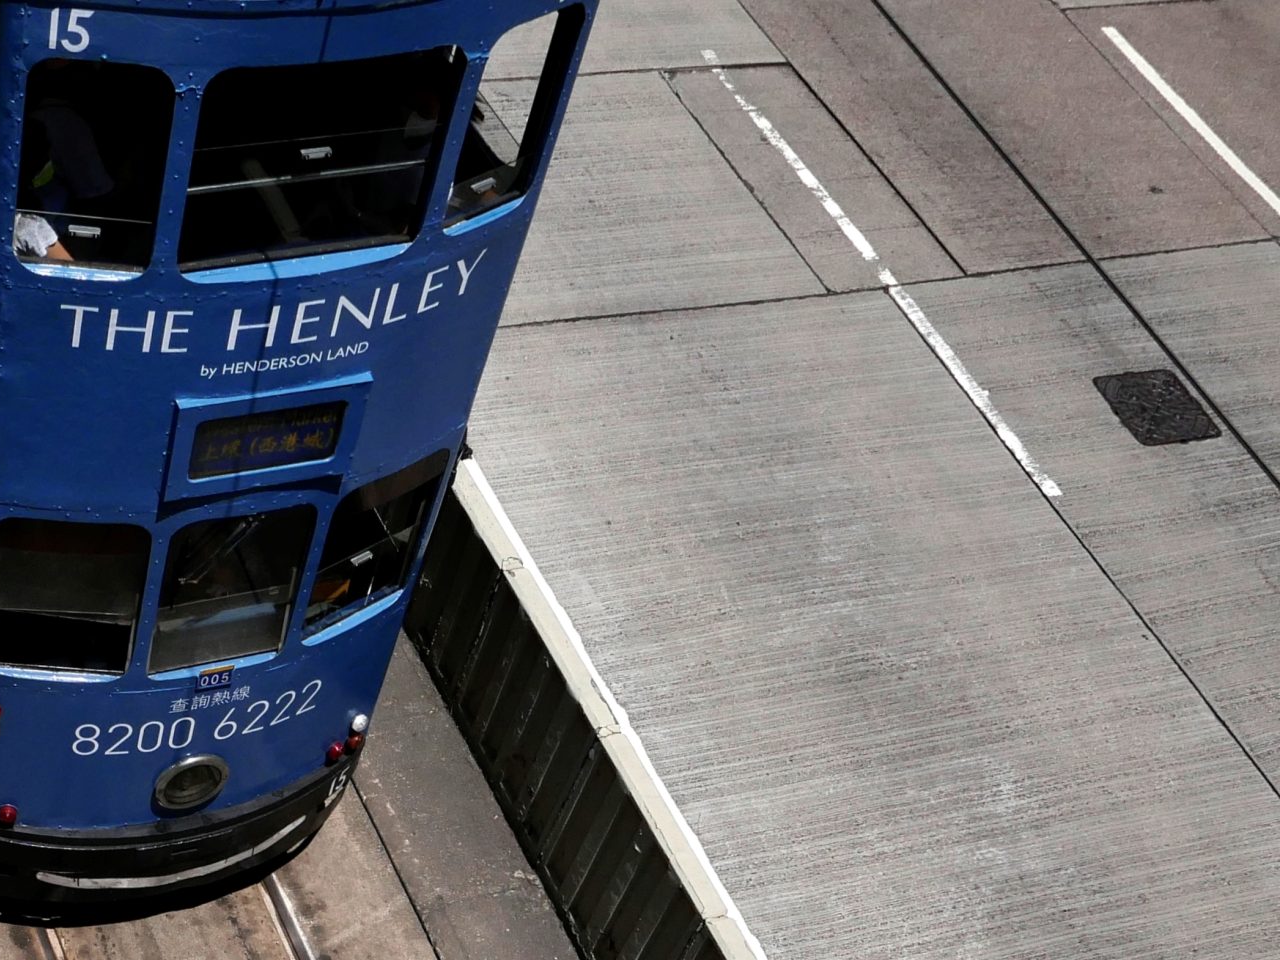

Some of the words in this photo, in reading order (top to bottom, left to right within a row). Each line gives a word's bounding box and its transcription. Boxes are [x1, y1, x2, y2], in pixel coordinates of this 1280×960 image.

[48, 7, 95, 53] 15
[60, 304, 194, 353] THE
[226, 248, 488, 351] HENLEY
[200, 365, 218, 380] by
[222, 351, 323, 376] HENDERSON
[326, 341, 370, 361] LAND
[200, 672, 230, 687] 005
[72, 716, 196, 756] 8200
[213, 679, 322, 740] 6222
[168, 685, 251, 714] 查詢熱線
[328, 766, 351, 797] 15
